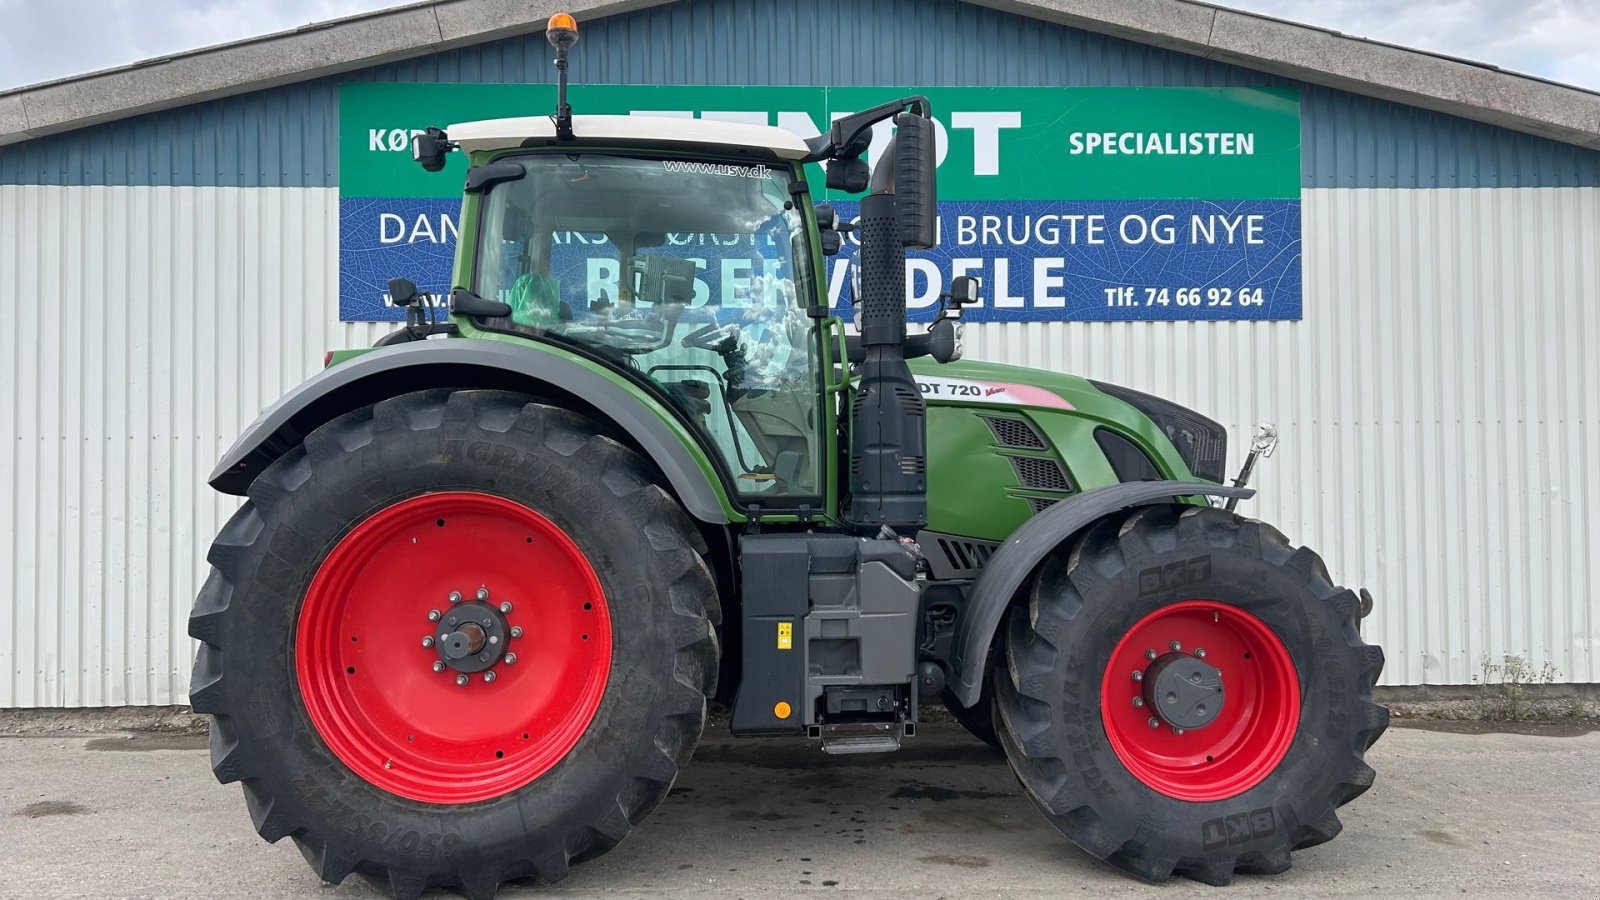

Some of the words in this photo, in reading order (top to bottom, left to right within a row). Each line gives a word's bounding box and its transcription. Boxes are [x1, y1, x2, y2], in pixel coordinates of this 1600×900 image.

[1069, 132, 1254, 155] SPECIALISTEN
[662, 160, 772, 180] www.usv.dk
[957, 215, 1105, 245] BRUGTE
[1119, 215, 1175, 245] OG
[1191, 215, 1264, 244] NYE
[1104, 287, 1139, 307] Tlf.
[1145, 288, 1169, 306] 74
[1176, 288, 1201, 306] 66
[1207, 288, 1232, 306] 92
[1238, 288, 1264, 306] 64
[947, 385, 981, 396] 720
[1139, 553, 1211, 598] BKT
[1200, 806, 1276, 852] BKT
